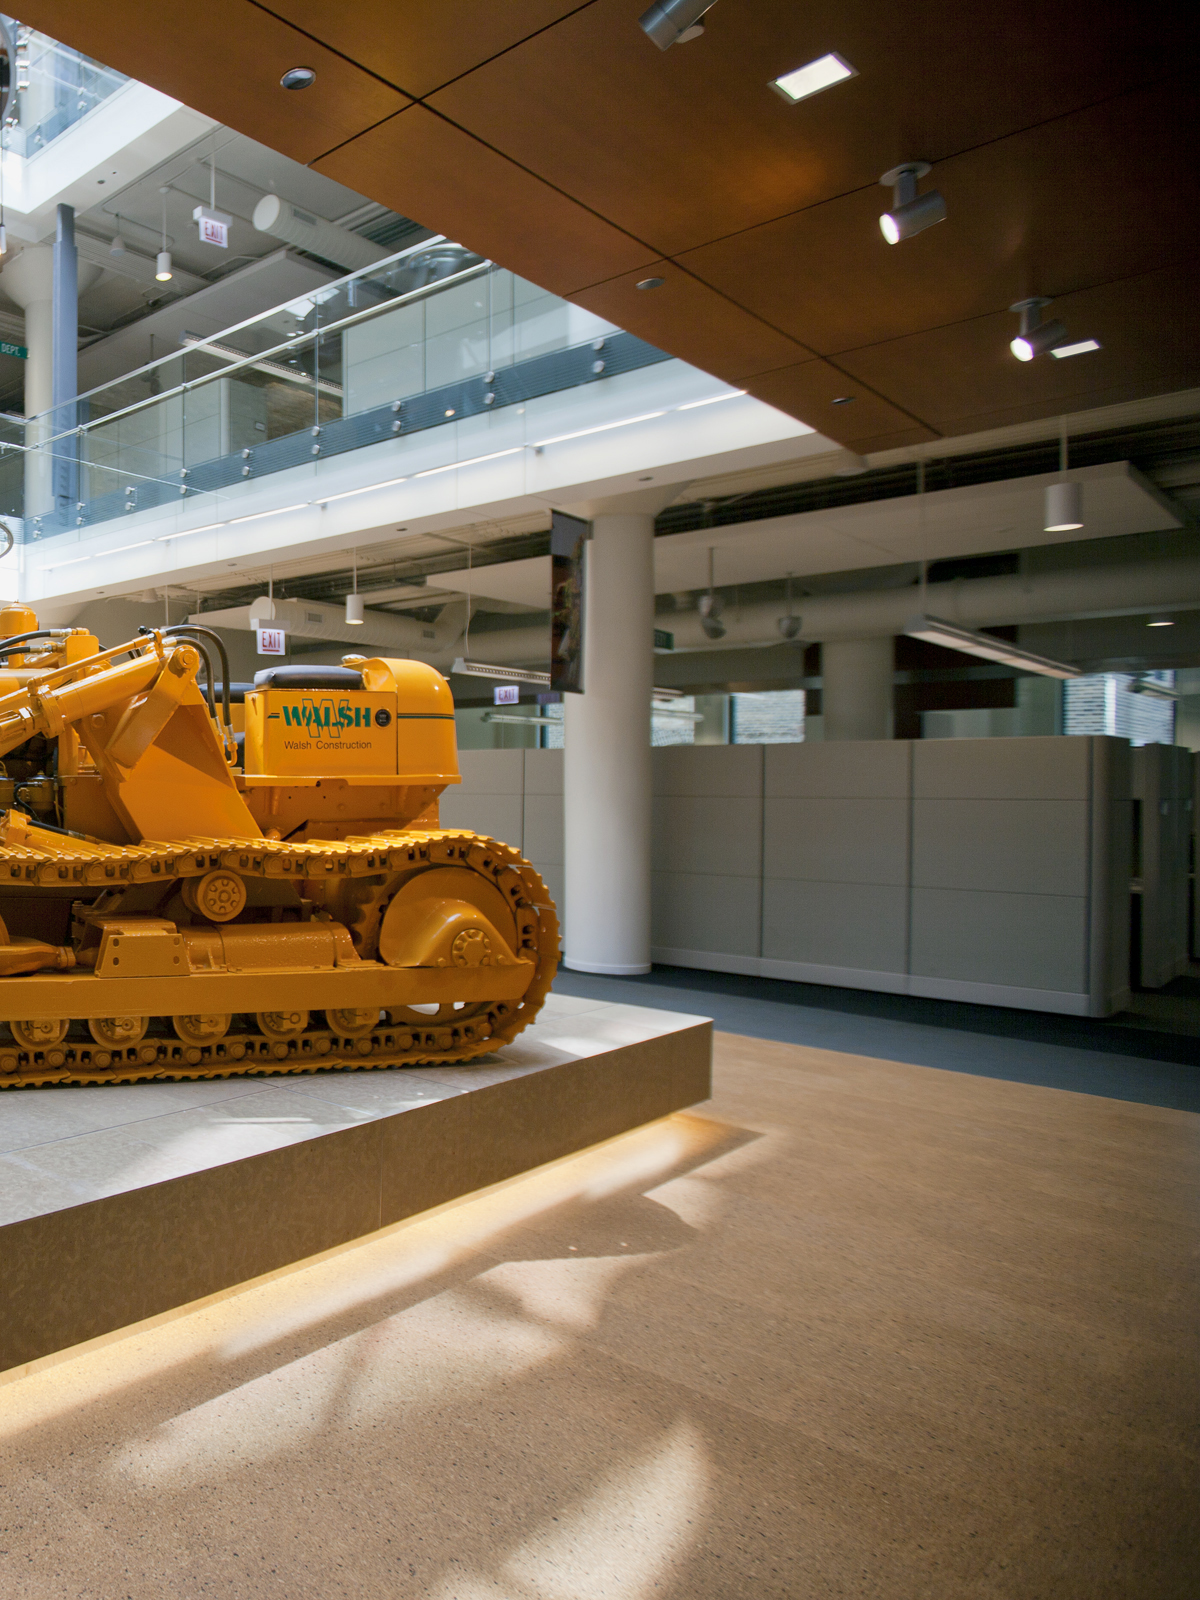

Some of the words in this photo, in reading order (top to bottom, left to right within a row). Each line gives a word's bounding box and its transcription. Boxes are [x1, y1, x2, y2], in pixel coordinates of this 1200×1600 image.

[205, 221, 223, 241] EXIT
[262, 631, 280, 648] EXIT
[498, 689, 515, 700] EXIT
[282, 705, 371, 728] WALSH
[284, 740, 312, 749] Walsh
[316, 740, 372, 749] Construction
